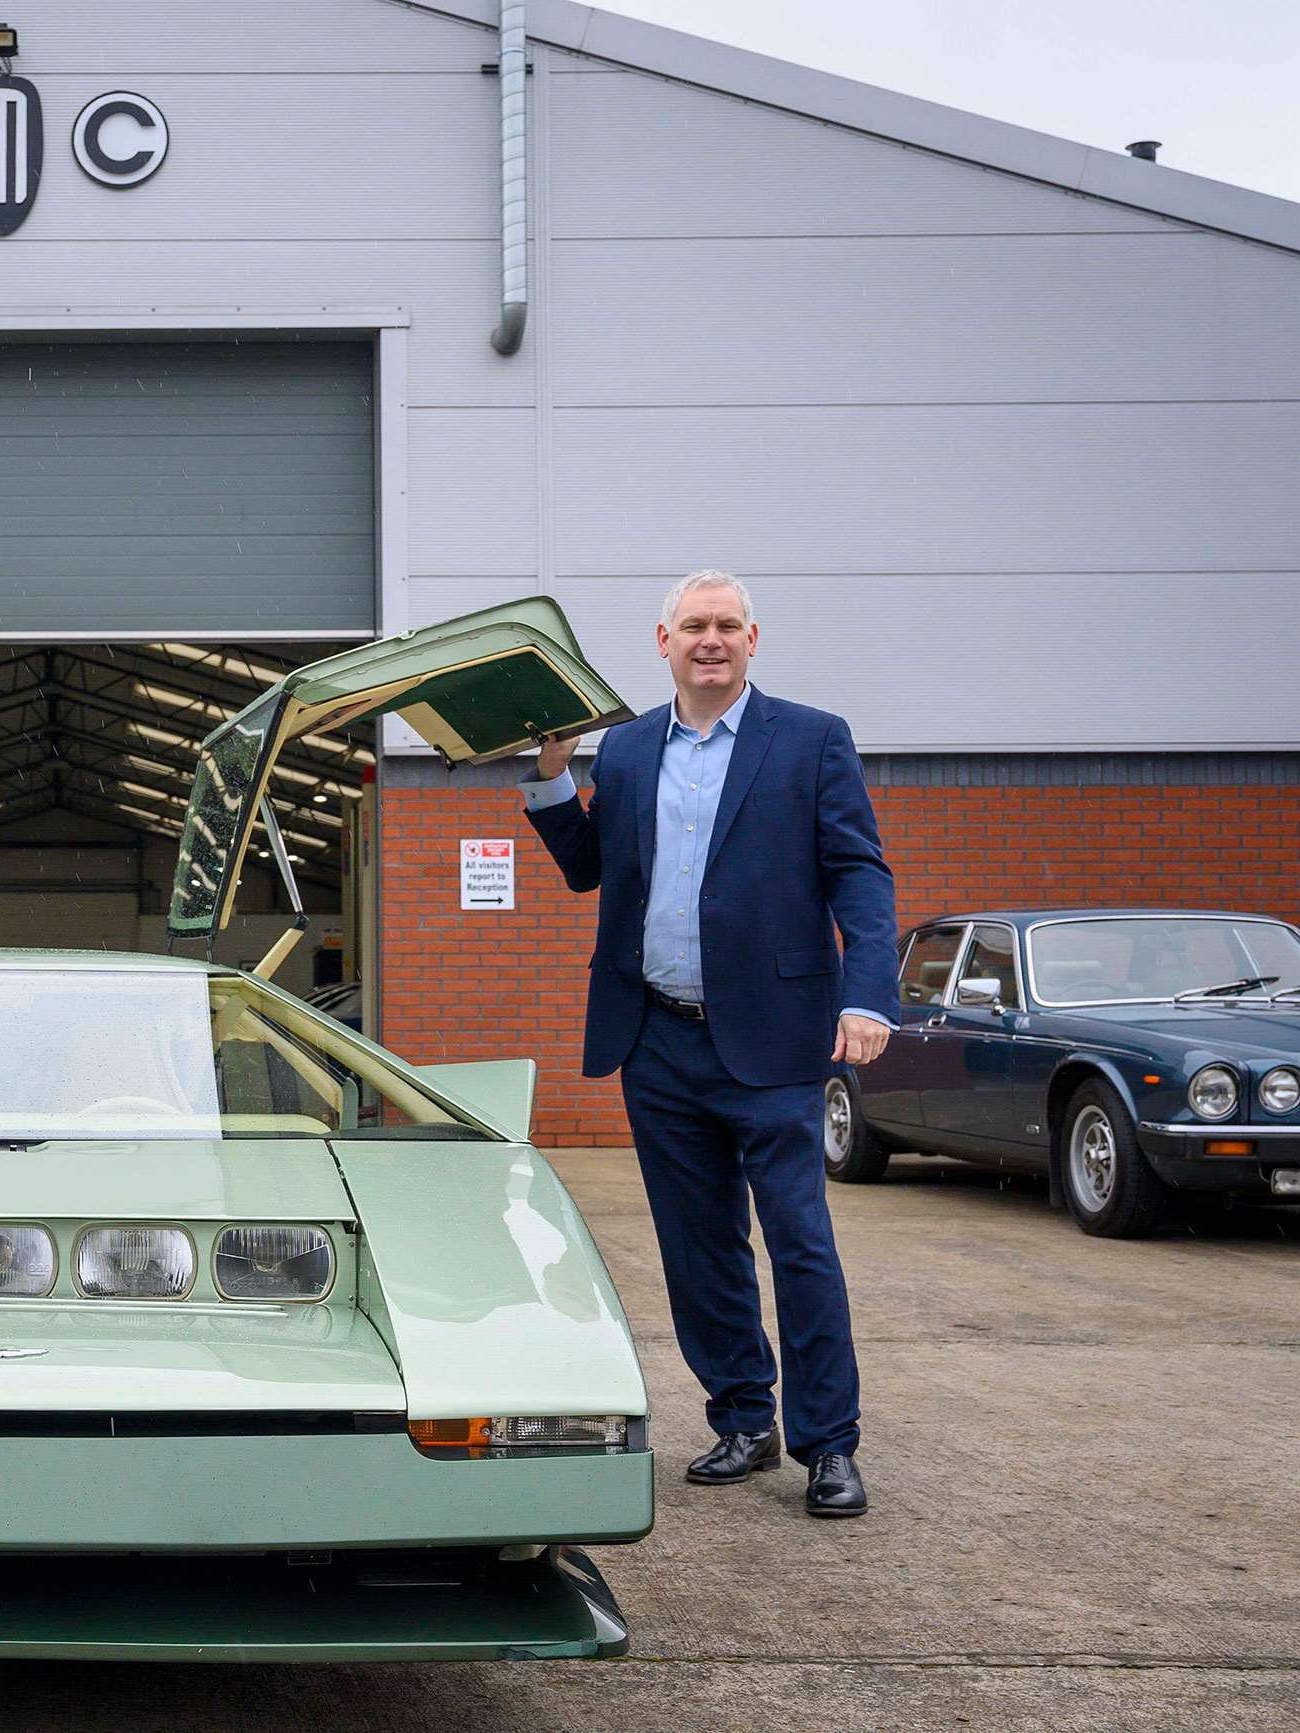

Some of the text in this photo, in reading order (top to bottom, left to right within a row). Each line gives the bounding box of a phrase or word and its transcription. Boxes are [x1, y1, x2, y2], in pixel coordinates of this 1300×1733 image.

[465, 861, 508, 869] All visitors
[469, 873, 494, 881] report
[467, 883, 508, 892] Reception
